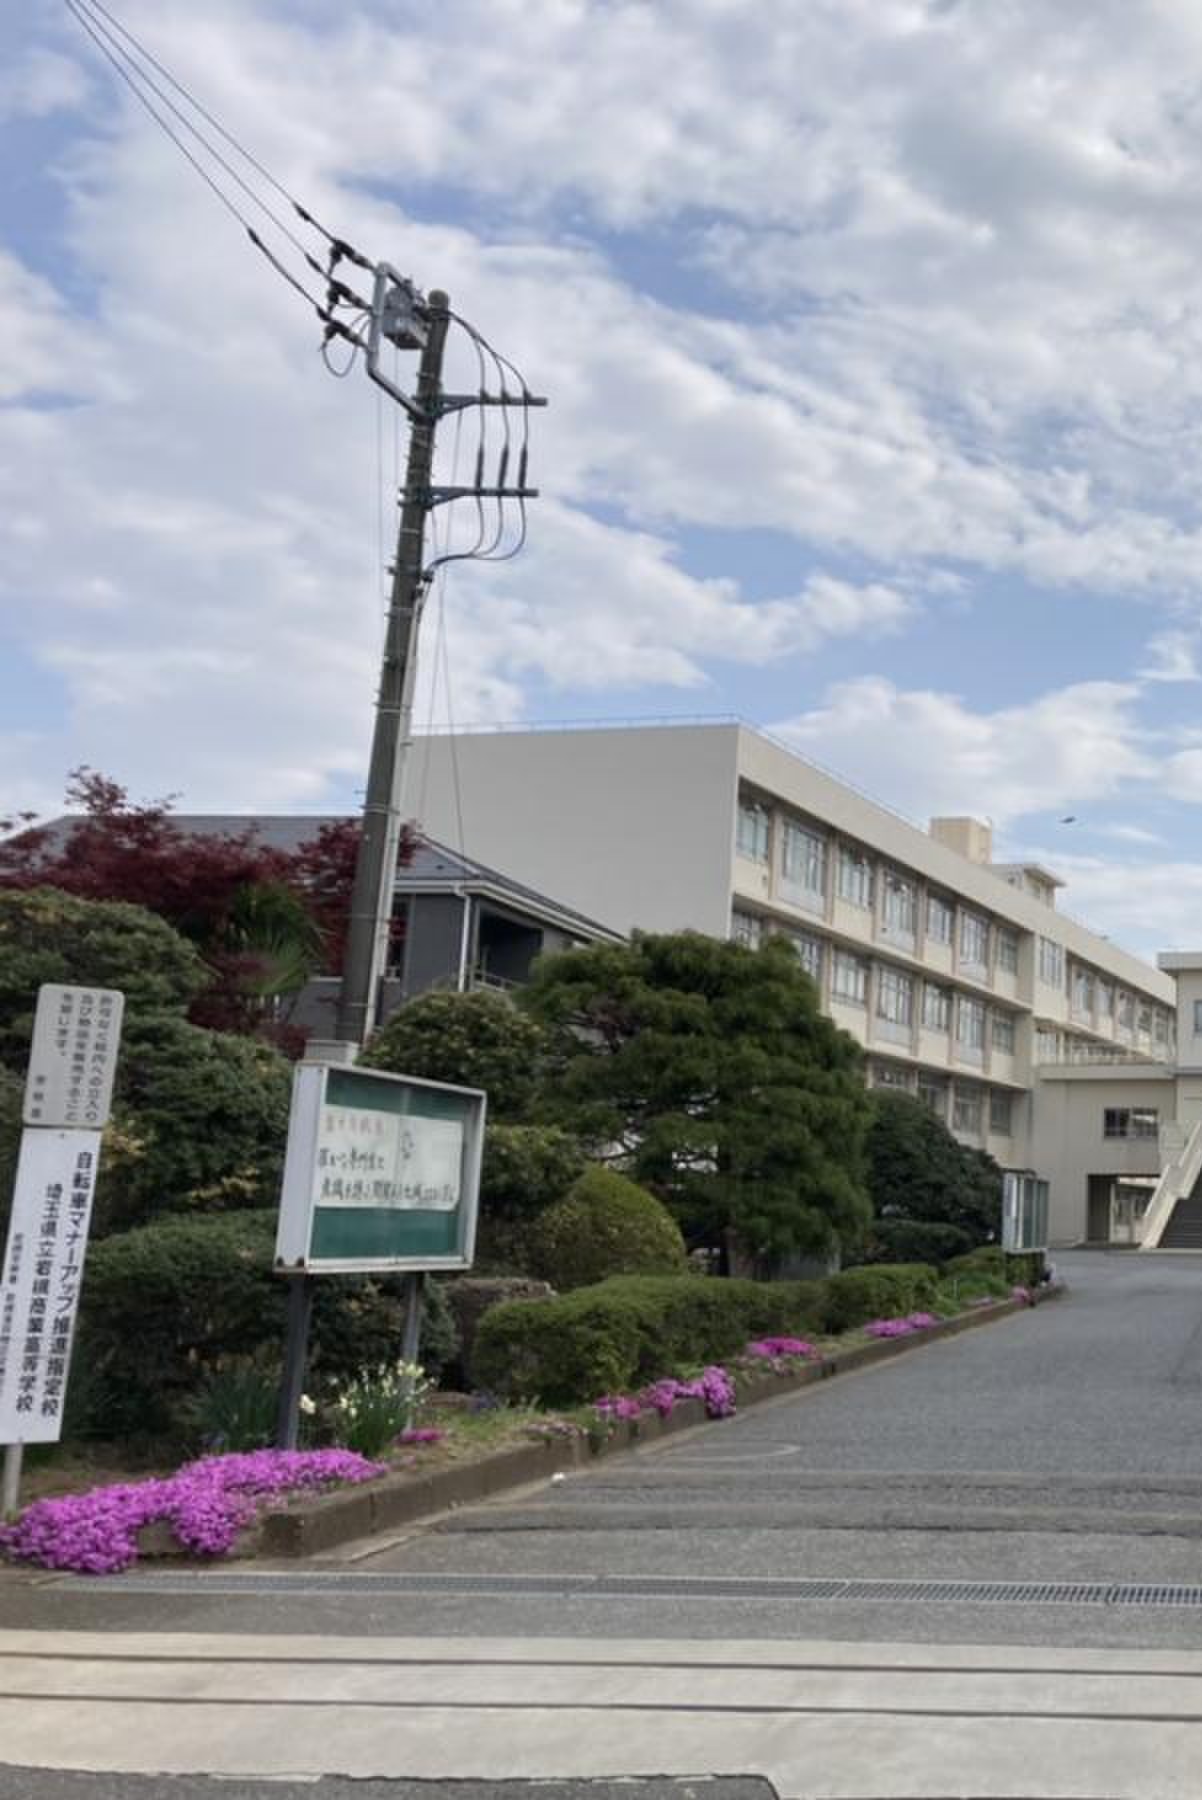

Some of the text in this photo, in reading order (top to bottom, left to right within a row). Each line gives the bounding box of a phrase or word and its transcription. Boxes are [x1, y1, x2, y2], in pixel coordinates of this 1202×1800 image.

[16, 1183, 63, 1412] 埼玉県立岩槻商業高等学校
[41, 1151, 93, 1417] 自転車マナーアップ推進指定校
